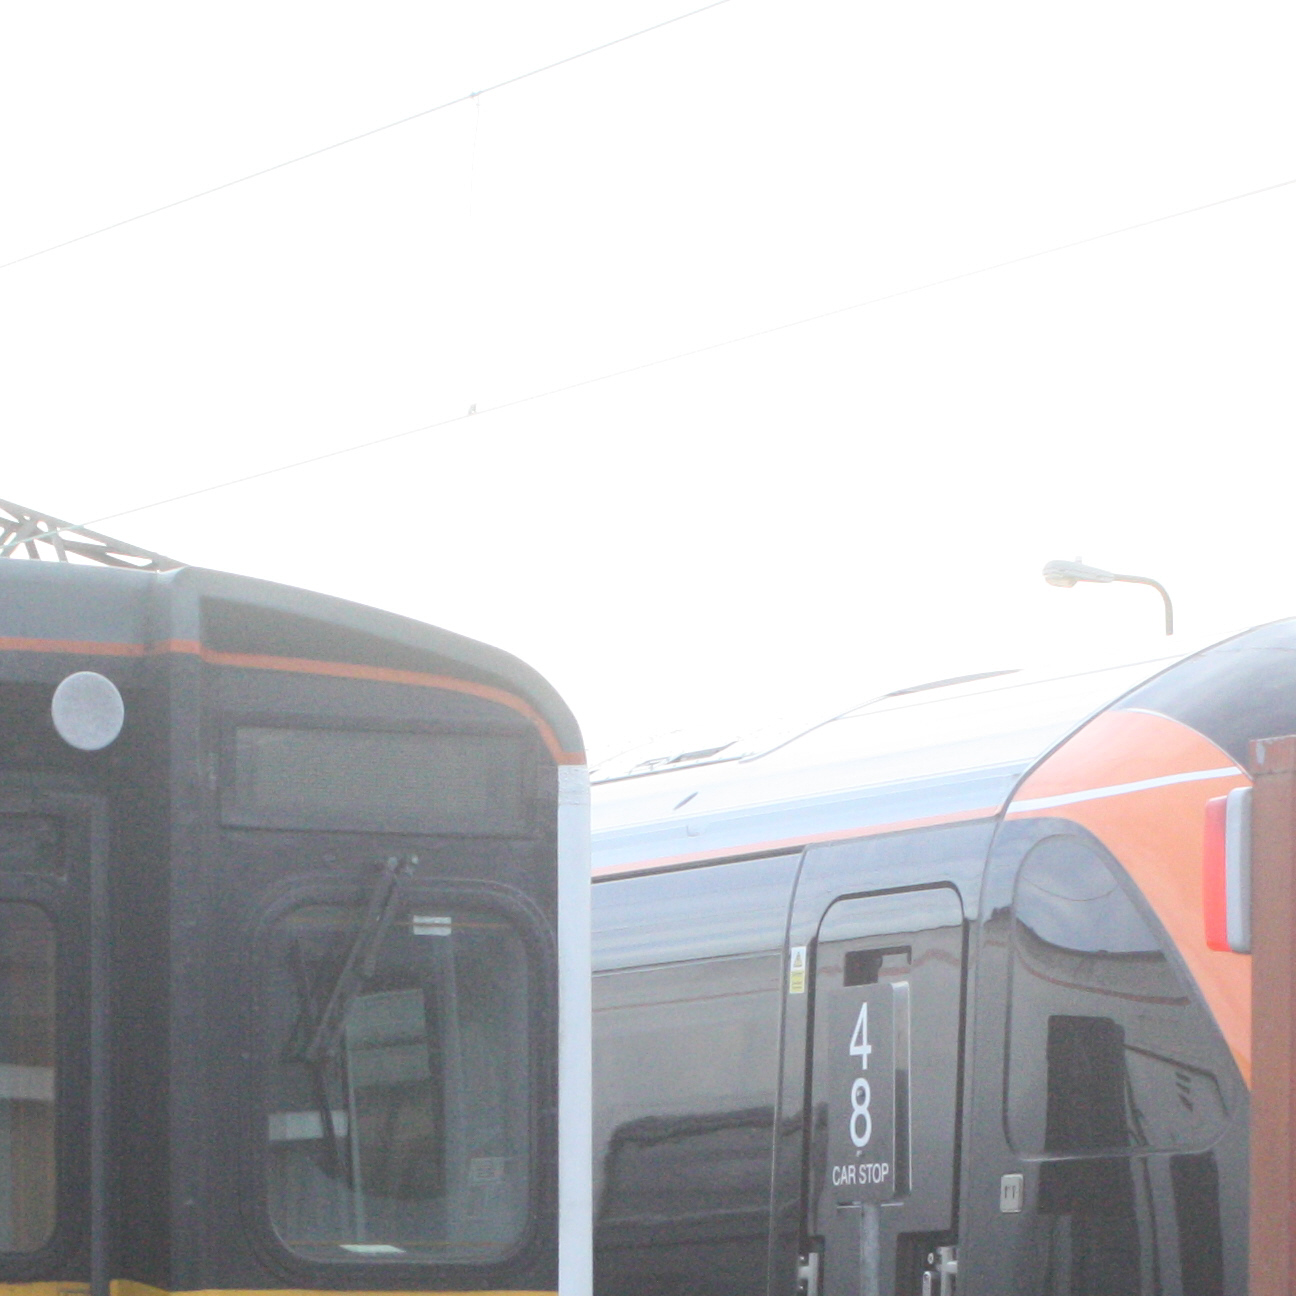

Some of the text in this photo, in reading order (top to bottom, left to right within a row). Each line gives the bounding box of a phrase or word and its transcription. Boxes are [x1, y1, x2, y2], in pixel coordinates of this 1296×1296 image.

[849, 1002, 872, 1070] 4
[850, 1077, 872, 1147] 8
[832, 1162, 889, 1186] CAR STOP
